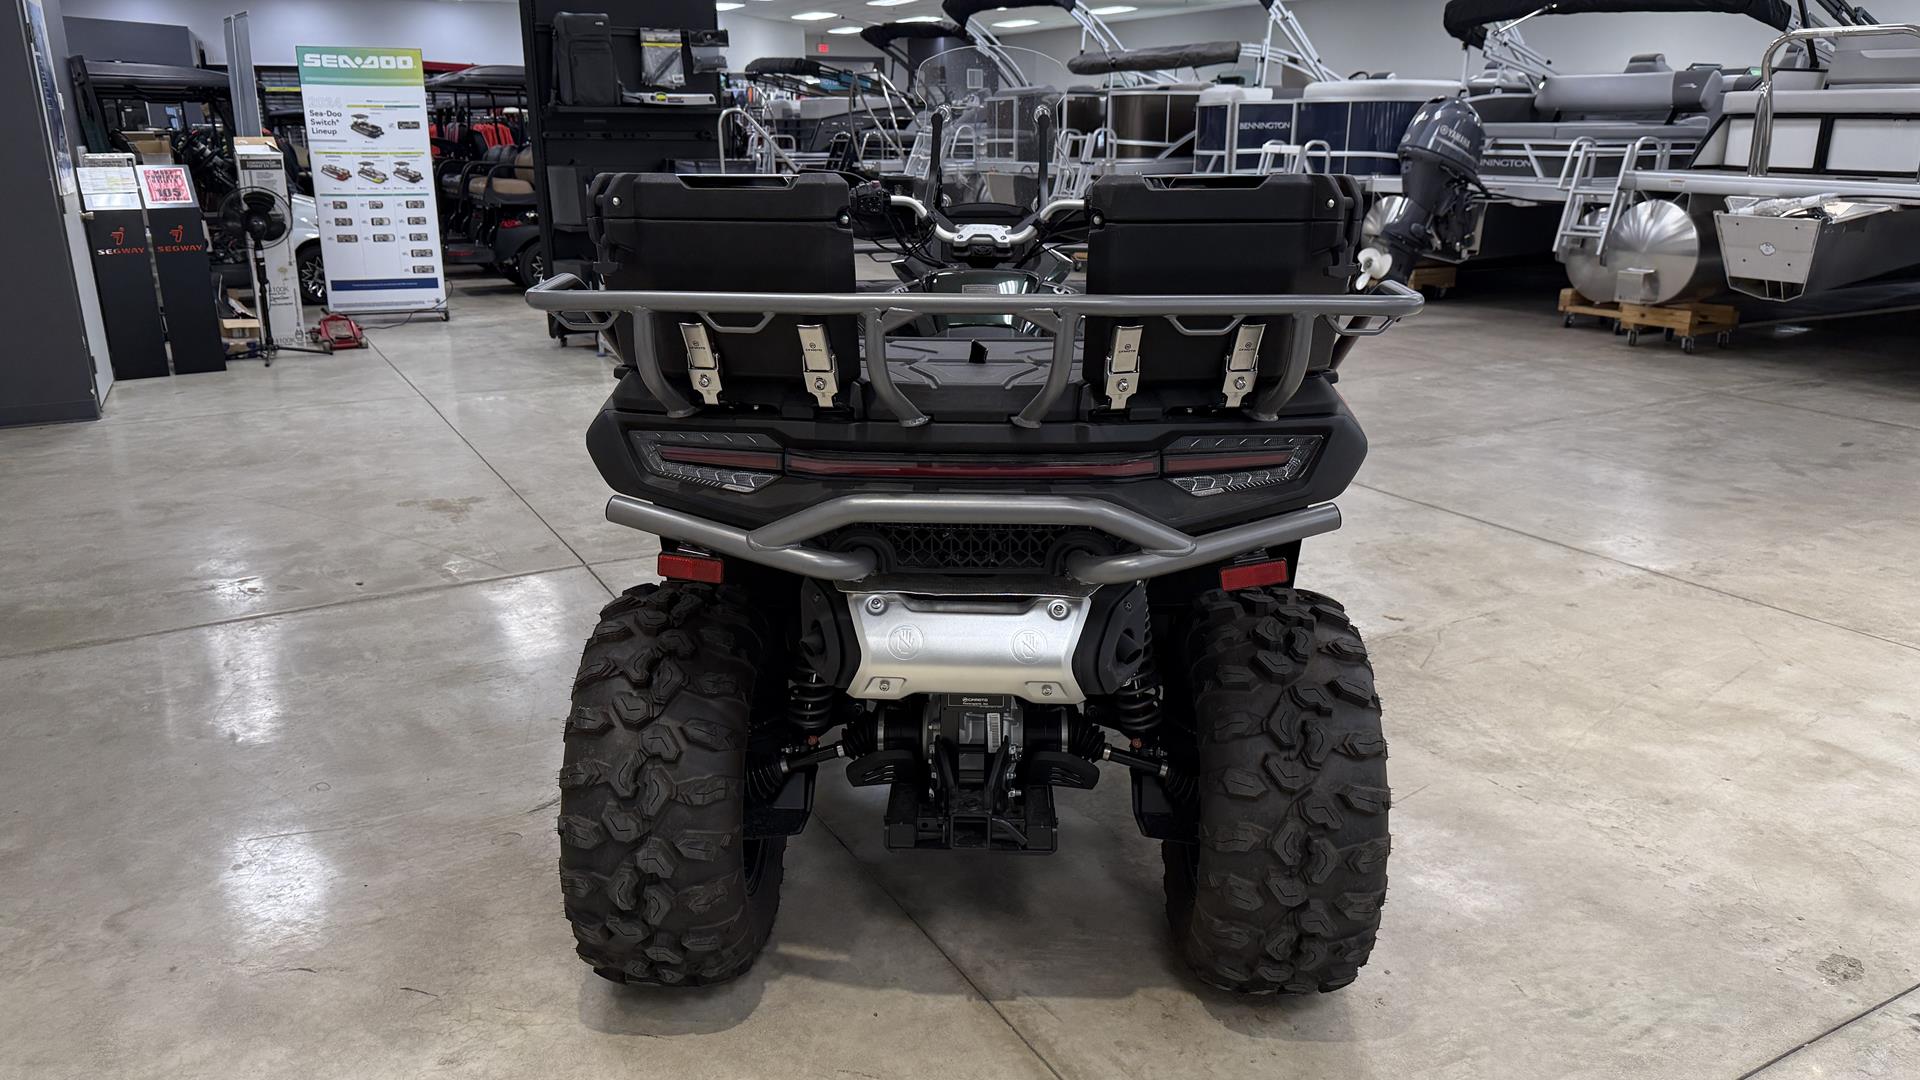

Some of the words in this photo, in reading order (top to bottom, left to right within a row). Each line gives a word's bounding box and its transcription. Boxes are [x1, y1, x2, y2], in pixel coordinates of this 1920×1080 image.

[309, 109, 342, 117] Sea-Doo
[1239, 121, 1290, 130] BENNINGTON
[311, 127, 338, 136] Lineup
[1448, 128, 1470, 148] YAMAHA
[1479, 158, 1531, 168] NINGTON
[97, 247, 144, 255] SEGWAY
[157, 244, 202, 253] SEGWAY
